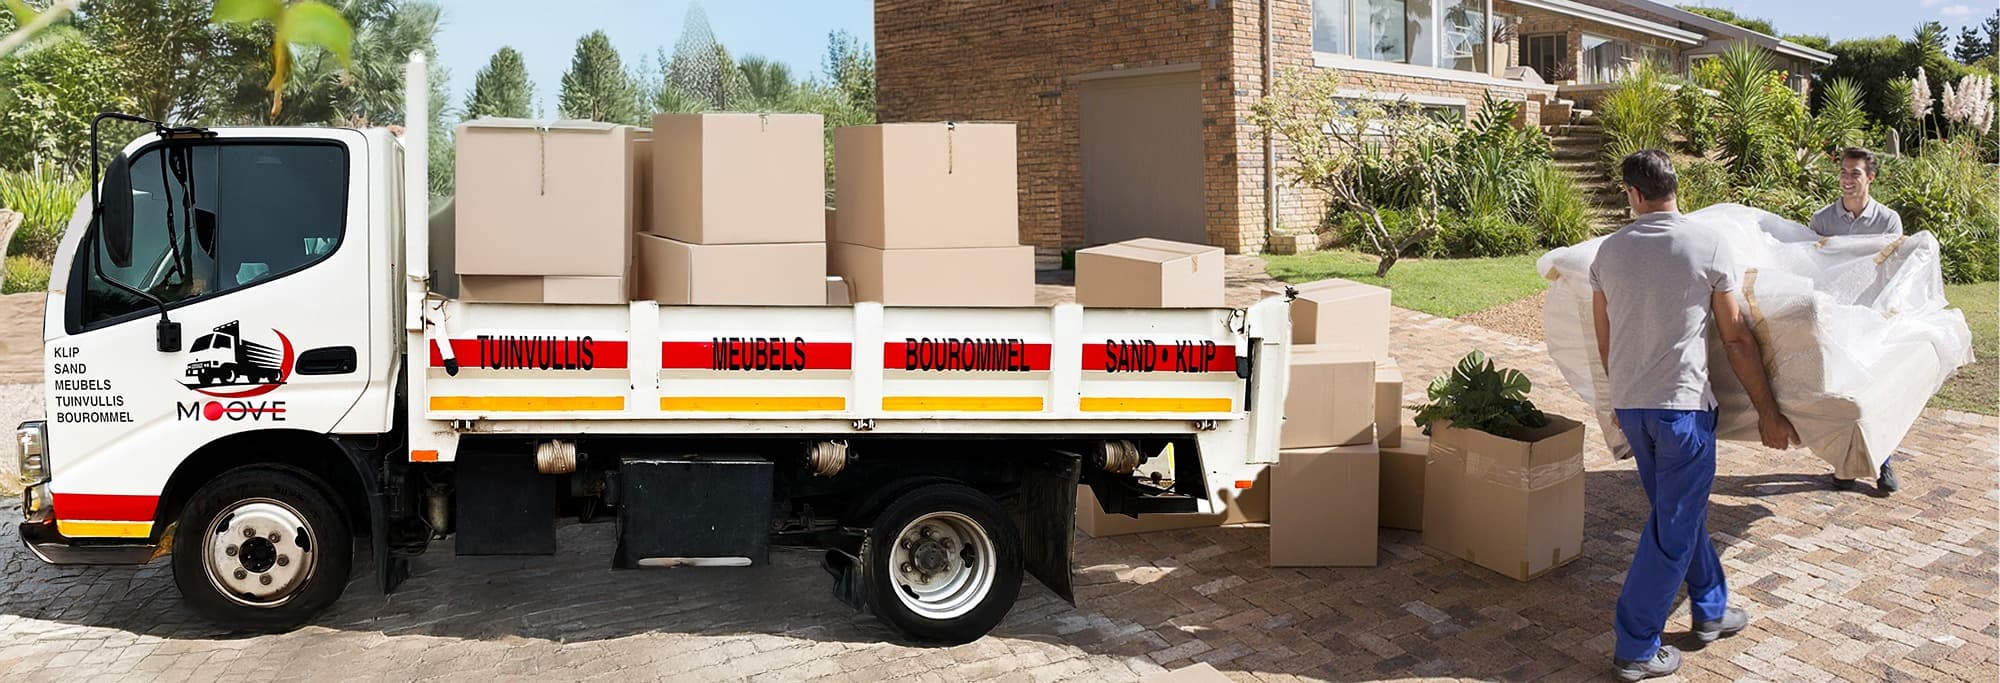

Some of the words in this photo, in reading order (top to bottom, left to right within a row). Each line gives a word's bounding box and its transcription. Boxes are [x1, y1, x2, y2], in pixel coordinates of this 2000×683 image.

[54, 347, 80, 358] KLIP
[477, 335, 594, 371] TUINVULLIS
[712, 336, 806, 371] MEUBELS
[905, 337, 1030, 372] BOUROMMEL
[1105, 339, 1157, 374] SAND
[1175, 340, 1217, 374] KLIP
[54, 363, 87, 375] SAND
[55, 379, 112, 391] MEUBELS
[55, 395, 124, 408] TUINVULLIS
[57, 411, 134, 423] BOUROMMEL
